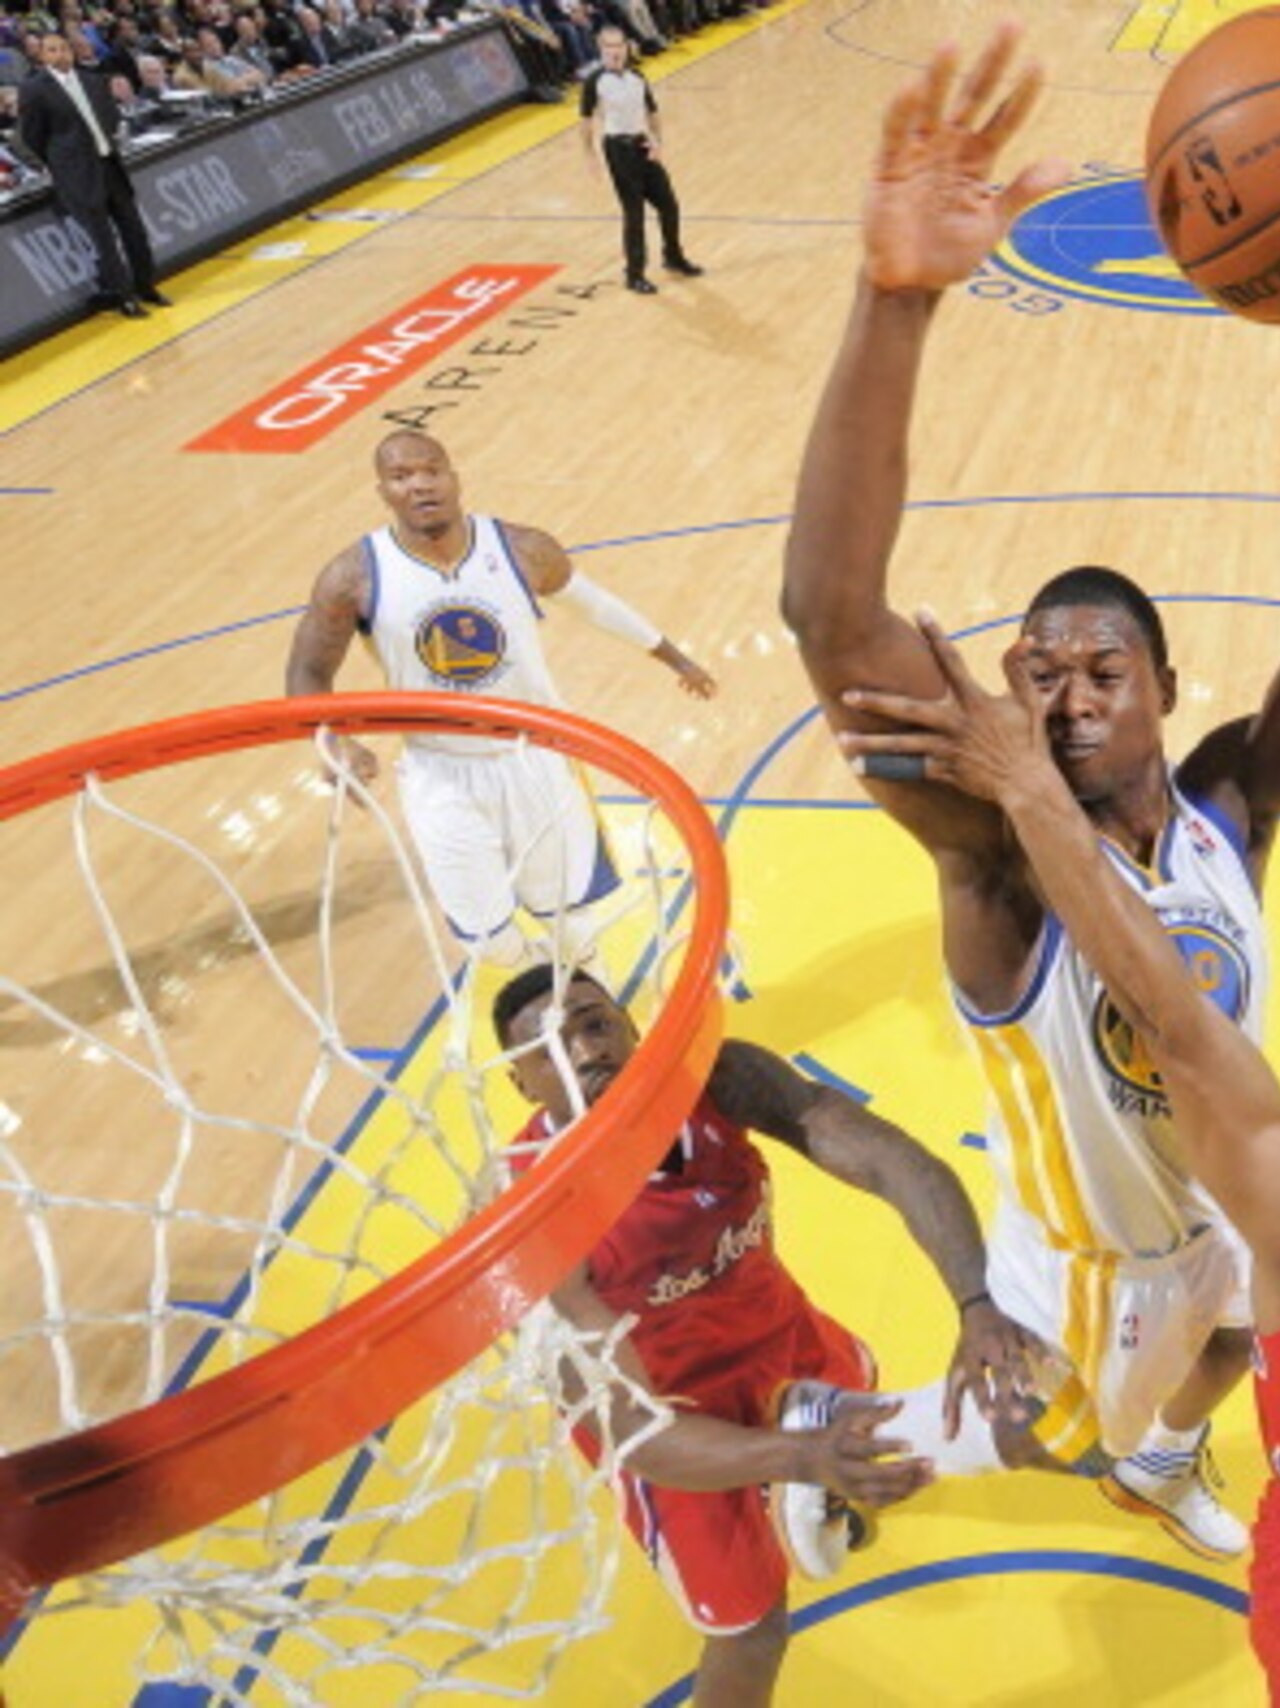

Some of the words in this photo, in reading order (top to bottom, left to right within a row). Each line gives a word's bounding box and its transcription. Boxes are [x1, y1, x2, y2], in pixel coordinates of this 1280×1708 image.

[333, 95, 391, 151] FEB
[253, 276, 521, 431] ORACLE
[381, 279, 617, 430] ARENA
[1192, 951, 1222, 994] 0
